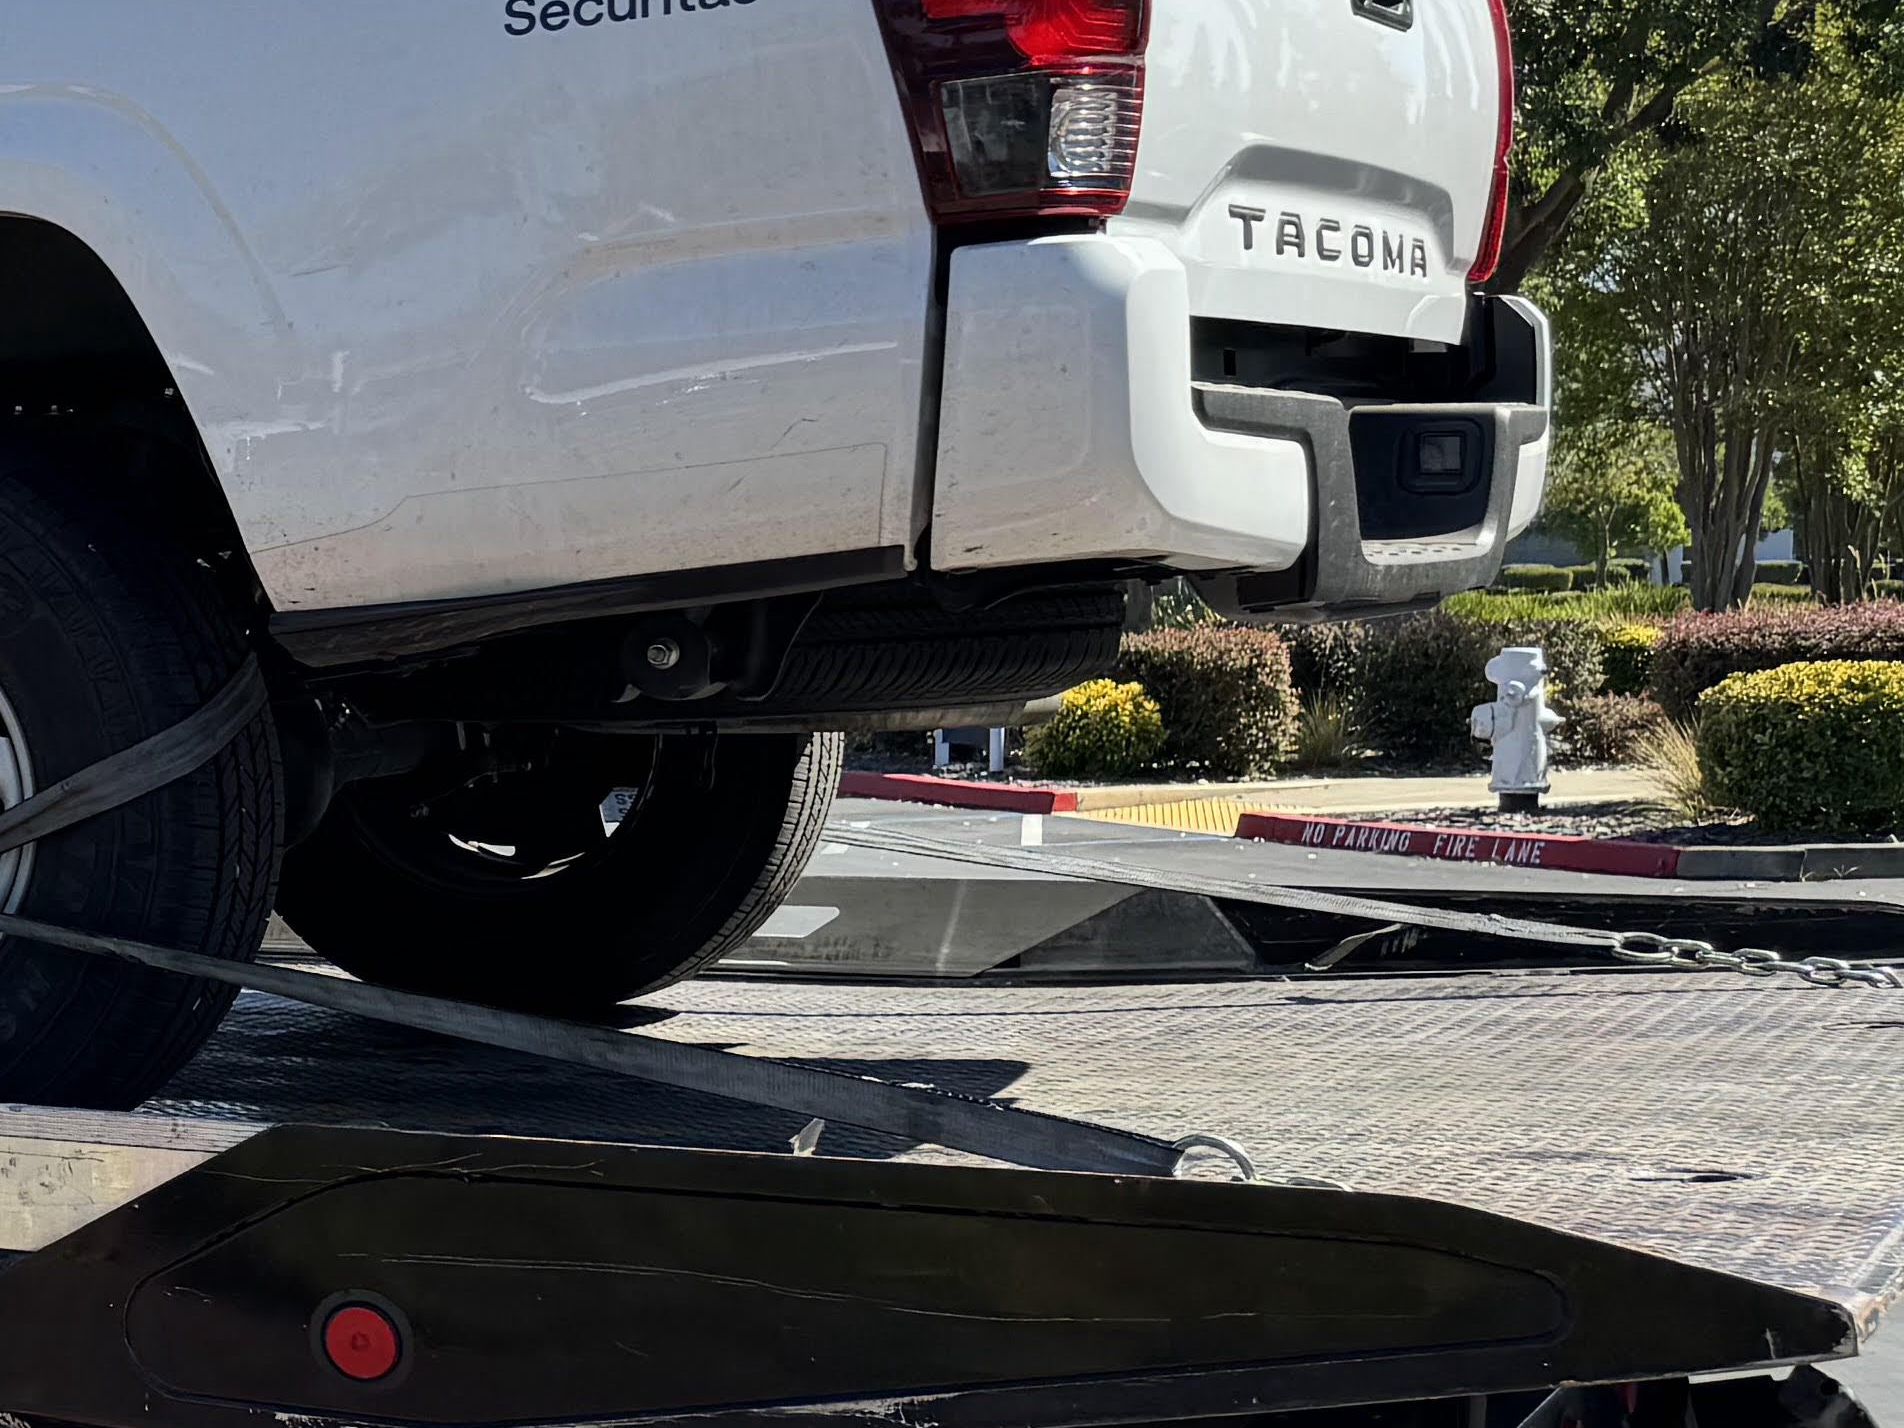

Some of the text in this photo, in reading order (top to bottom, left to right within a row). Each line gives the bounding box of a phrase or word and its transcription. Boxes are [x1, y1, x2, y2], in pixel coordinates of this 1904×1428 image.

[1227, 203, 1430, 279] TACOMA
[1301, 822, 1546, 864] NO PARKING FIRE LANE
